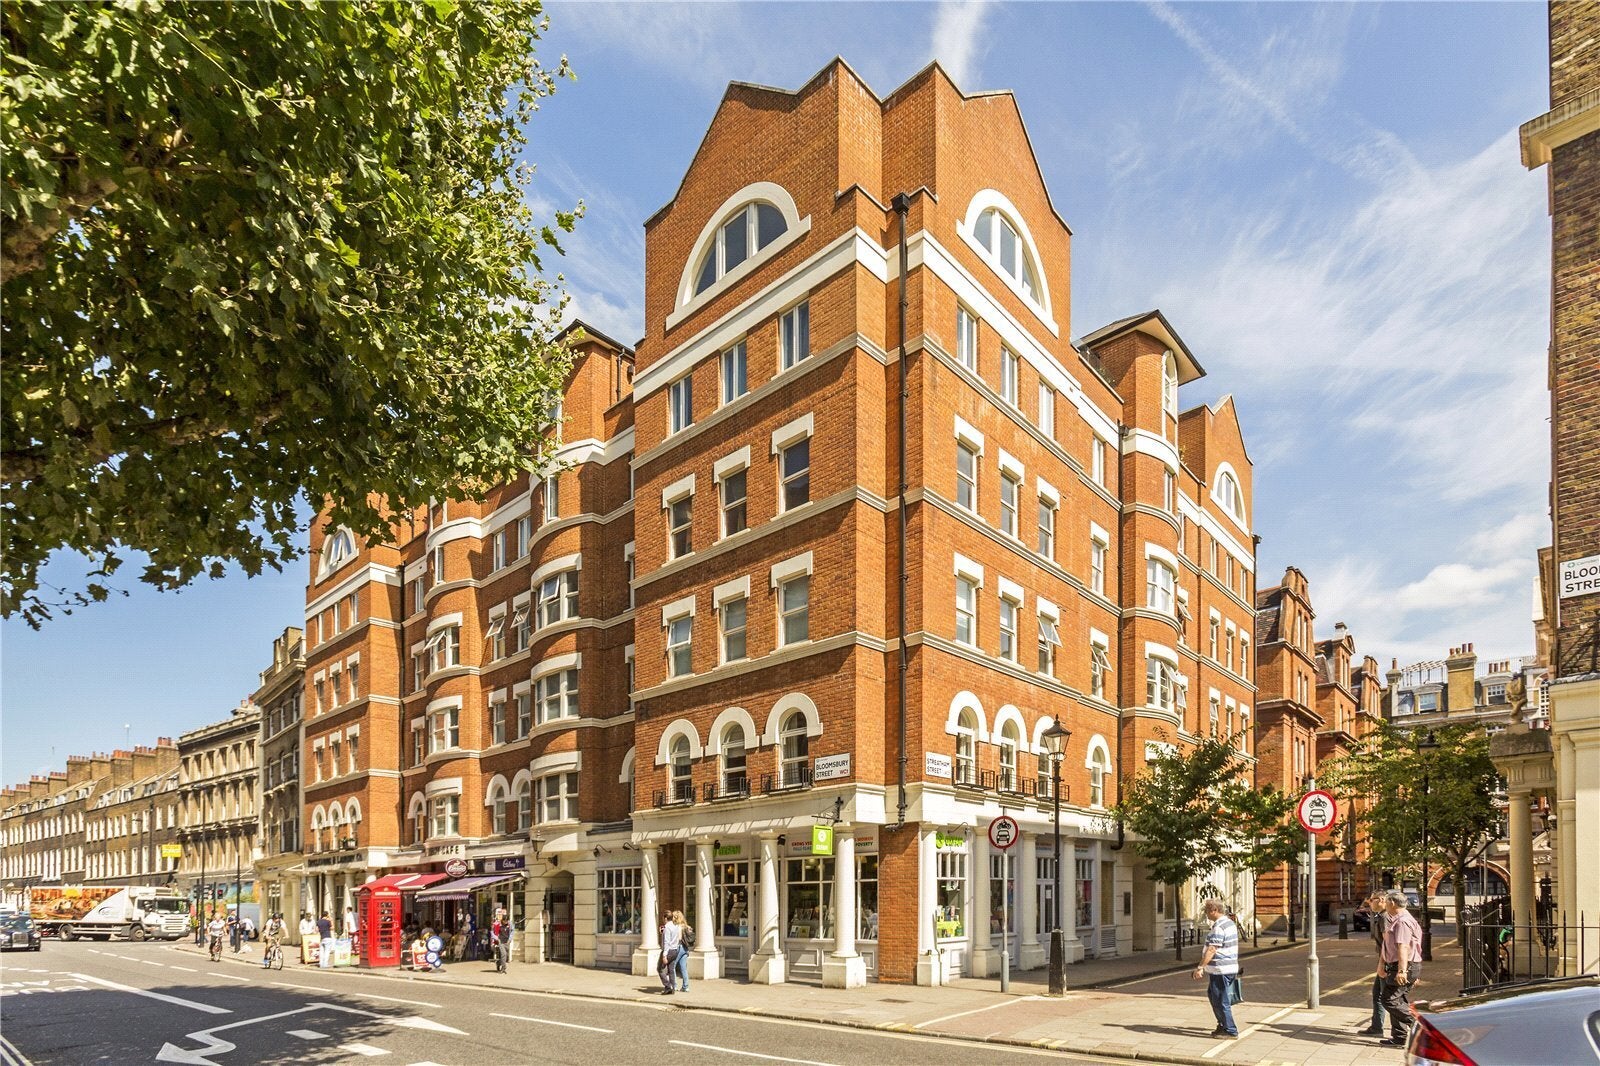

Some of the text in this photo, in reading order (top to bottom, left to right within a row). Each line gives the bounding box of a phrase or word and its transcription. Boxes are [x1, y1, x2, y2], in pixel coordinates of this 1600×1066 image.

[1565, 566, 1600, 580] BLOO
[816, 760, 848, 770] BLOOMSBURY
[816, 770, 833, 778] STREET
